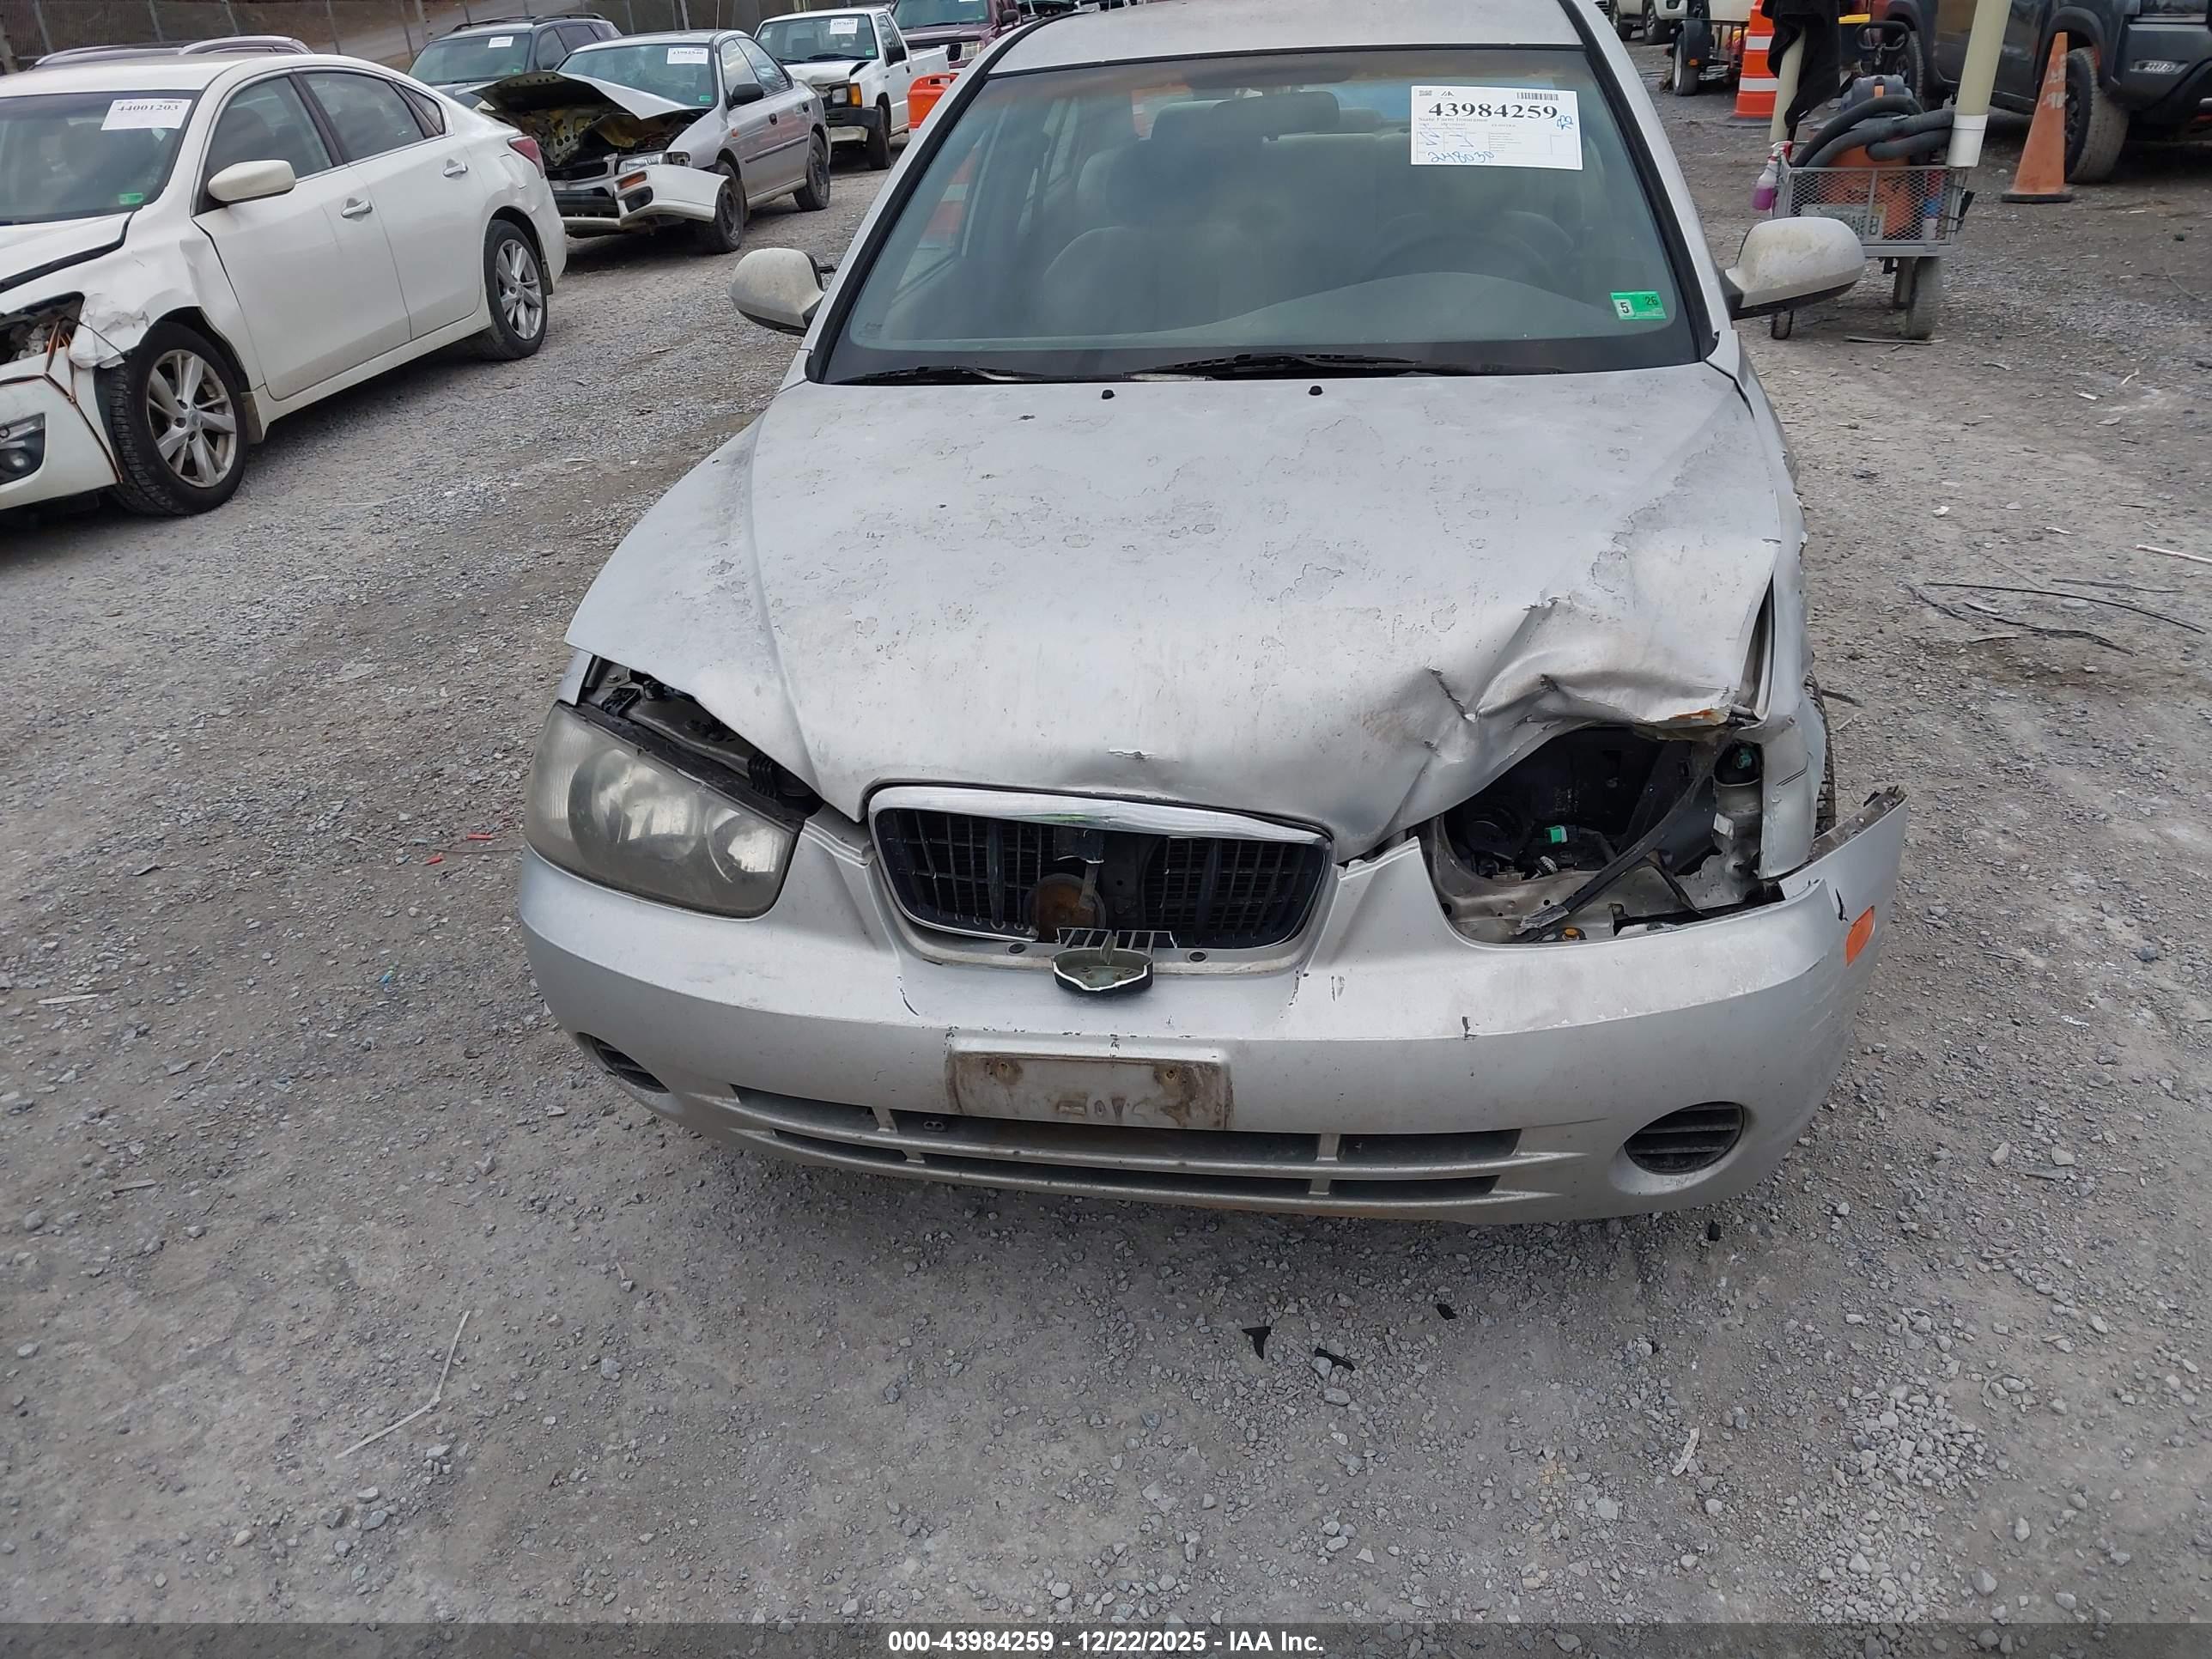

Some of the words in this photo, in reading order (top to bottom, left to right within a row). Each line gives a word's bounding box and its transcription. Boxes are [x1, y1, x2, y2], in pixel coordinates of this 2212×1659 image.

[1429, 102, 1558, 119] 43984259
[1645, 296, 1658, 305] 26
[1620, 302, 1629, 313] 5
